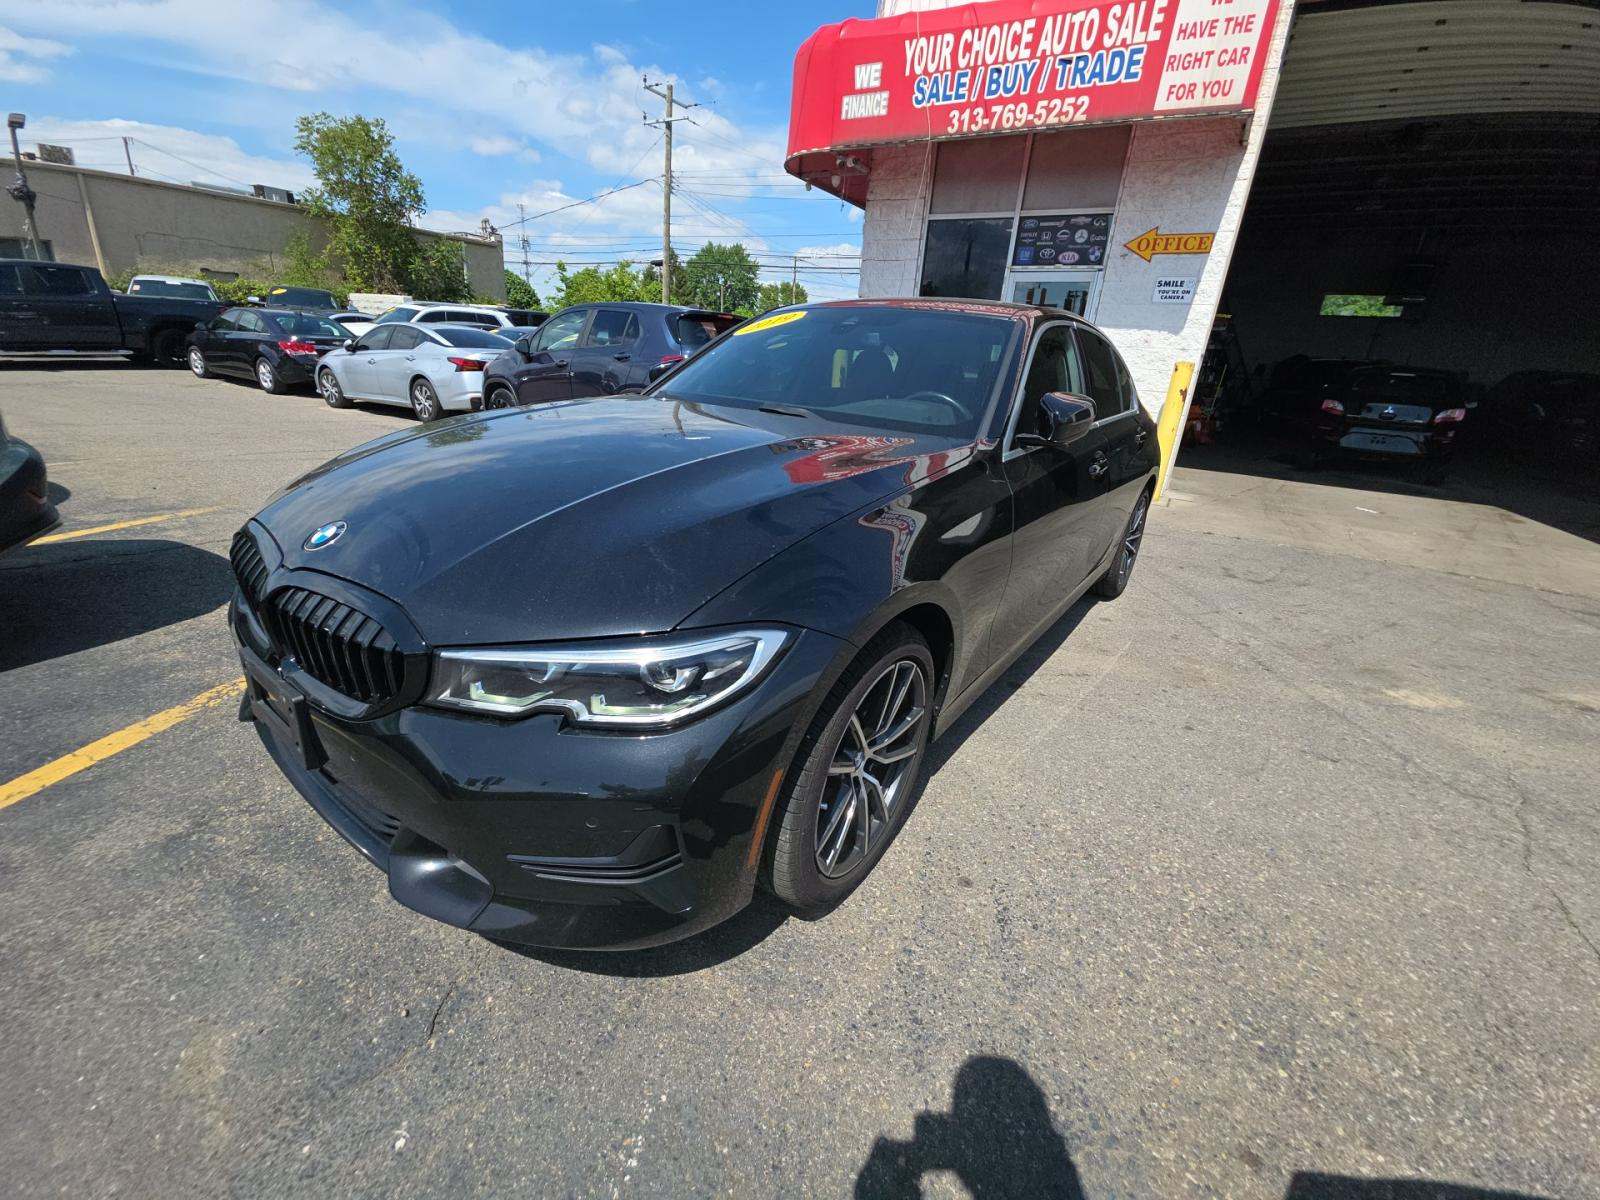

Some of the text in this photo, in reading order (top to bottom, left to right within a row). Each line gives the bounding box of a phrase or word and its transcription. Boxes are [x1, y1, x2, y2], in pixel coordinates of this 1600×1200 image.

[904, 0, 1168, 76] YOUR CHOICE AUTO SALE
[1176, 14, 1256, 41] HAVE THE
[1166, 46, 1250, 72] RIGHT CAR
[854, 62, 882, 90] WE
[912, 69, 971, 108] SALE
[984, 59, 1041, 99] BUY
[1055, 44, 1147, 91] TRADE
[1166, 78, 1234, 102] FOR YOU
[841, 91, 889, 120] FINANCE
[947, 95, 1090, 134] 313-769-5252
[1137, 235, 1210, 252] OFFICE
[1157, 280, 1185, 288] SMILE
